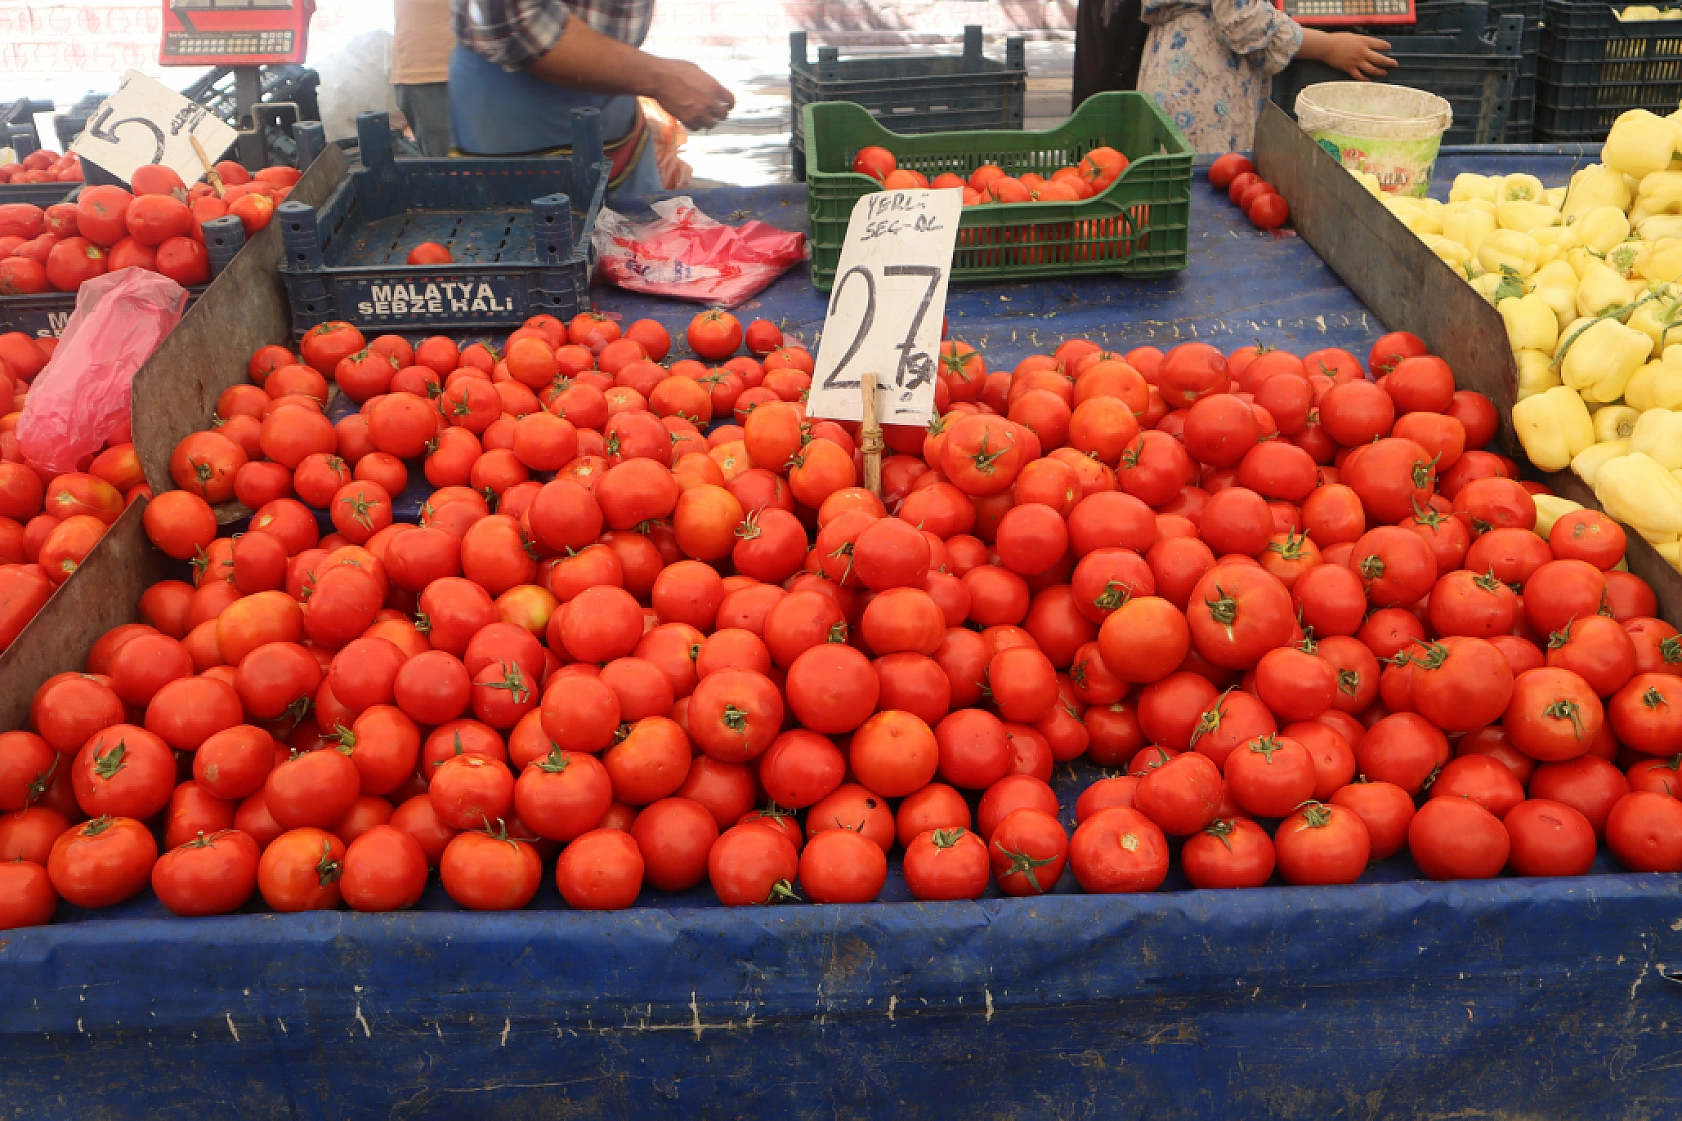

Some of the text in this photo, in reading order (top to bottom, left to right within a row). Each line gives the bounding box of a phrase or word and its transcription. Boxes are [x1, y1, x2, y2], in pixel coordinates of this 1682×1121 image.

[90, 106, 165, 164] 5
[371, 282, 495, 302] MALATYA
[357, 300, 444, 315] SEBZE
